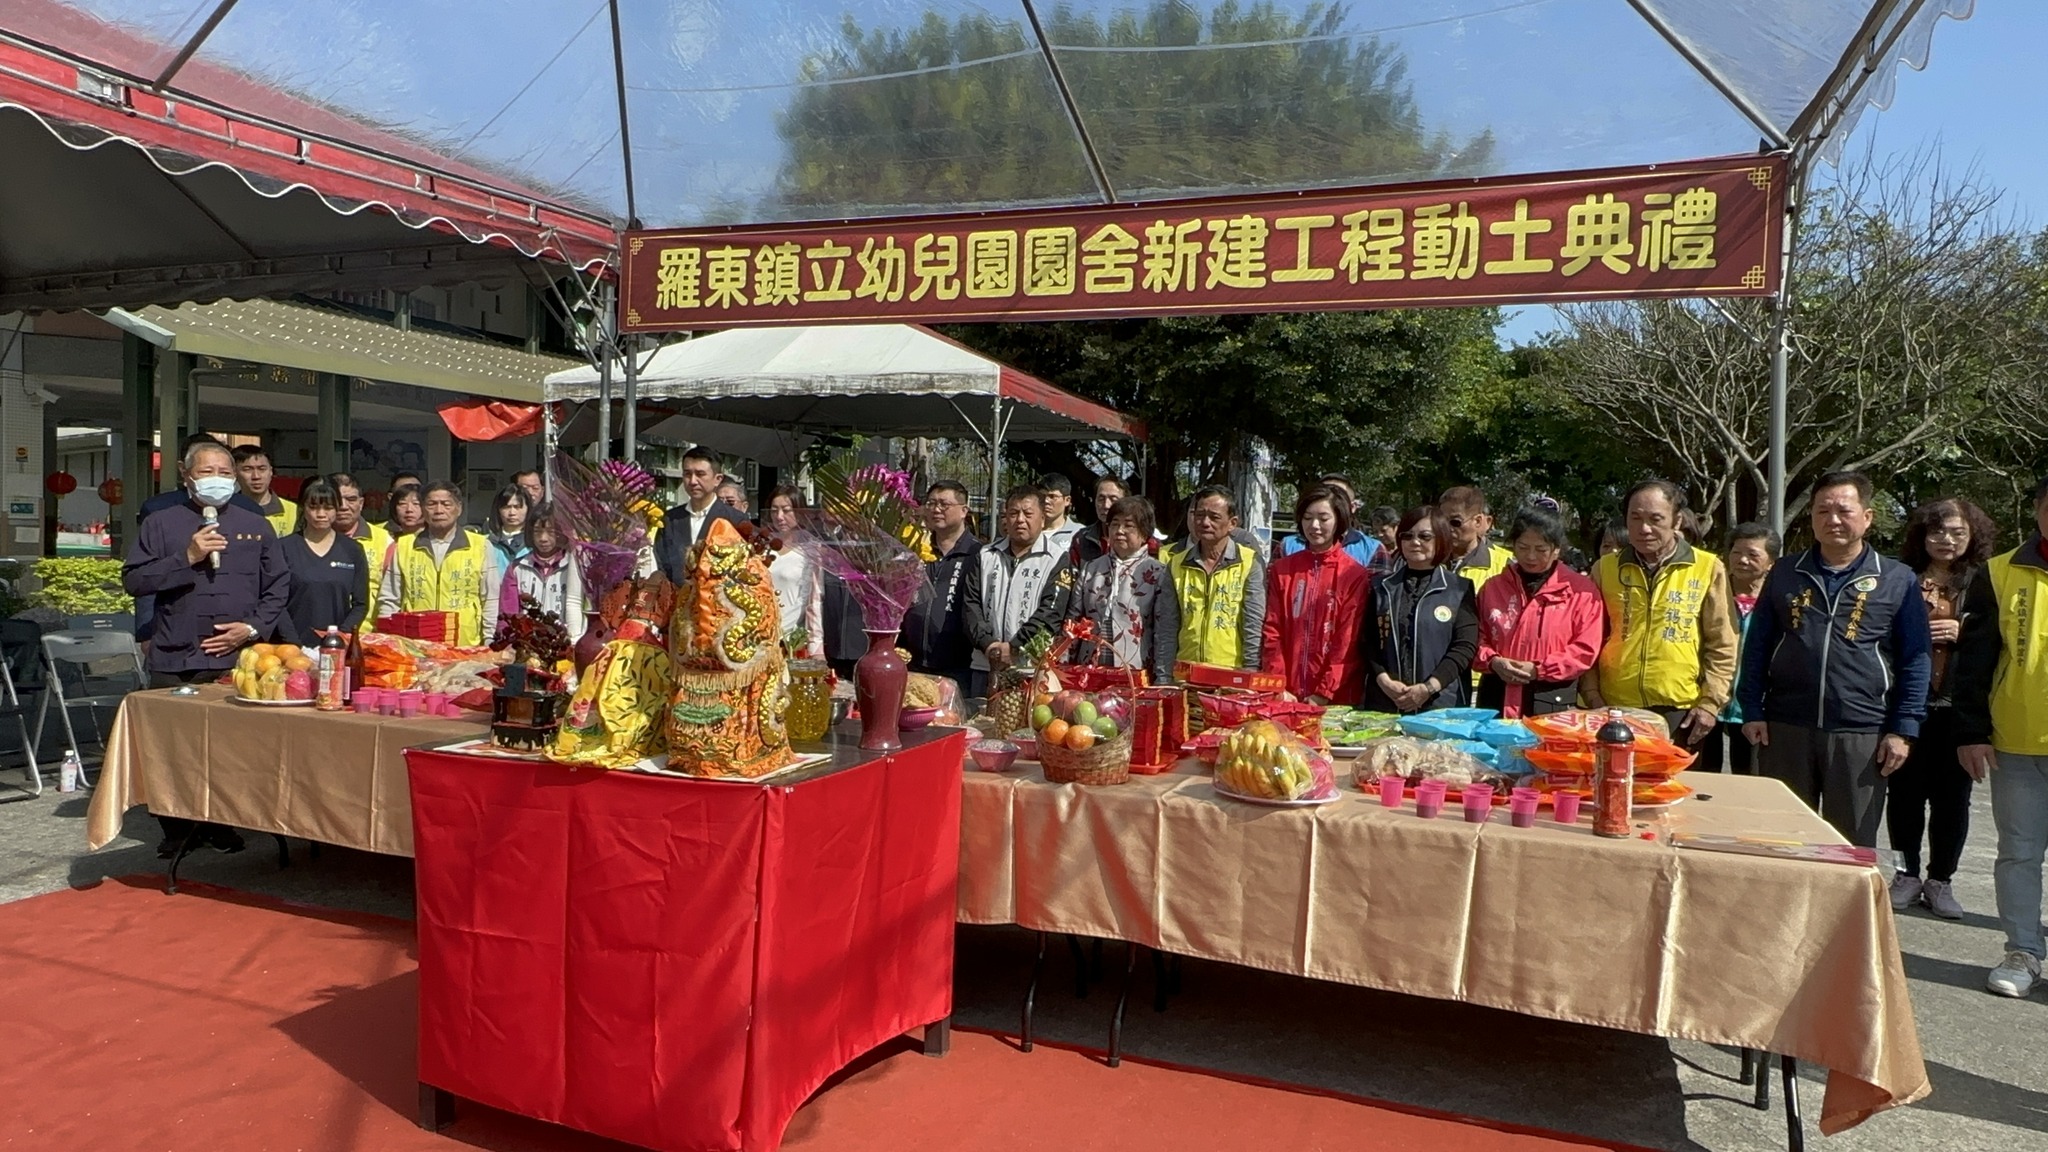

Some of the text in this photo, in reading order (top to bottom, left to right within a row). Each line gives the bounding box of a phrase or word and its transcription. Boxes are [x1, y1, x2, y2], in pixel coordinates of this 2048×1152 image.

[656, 186, 1717, 311] 羅東鎮立幼兒園園舍新建工程動土典禮
[1844, 591, 1868, 640] 羅東鎮公所
